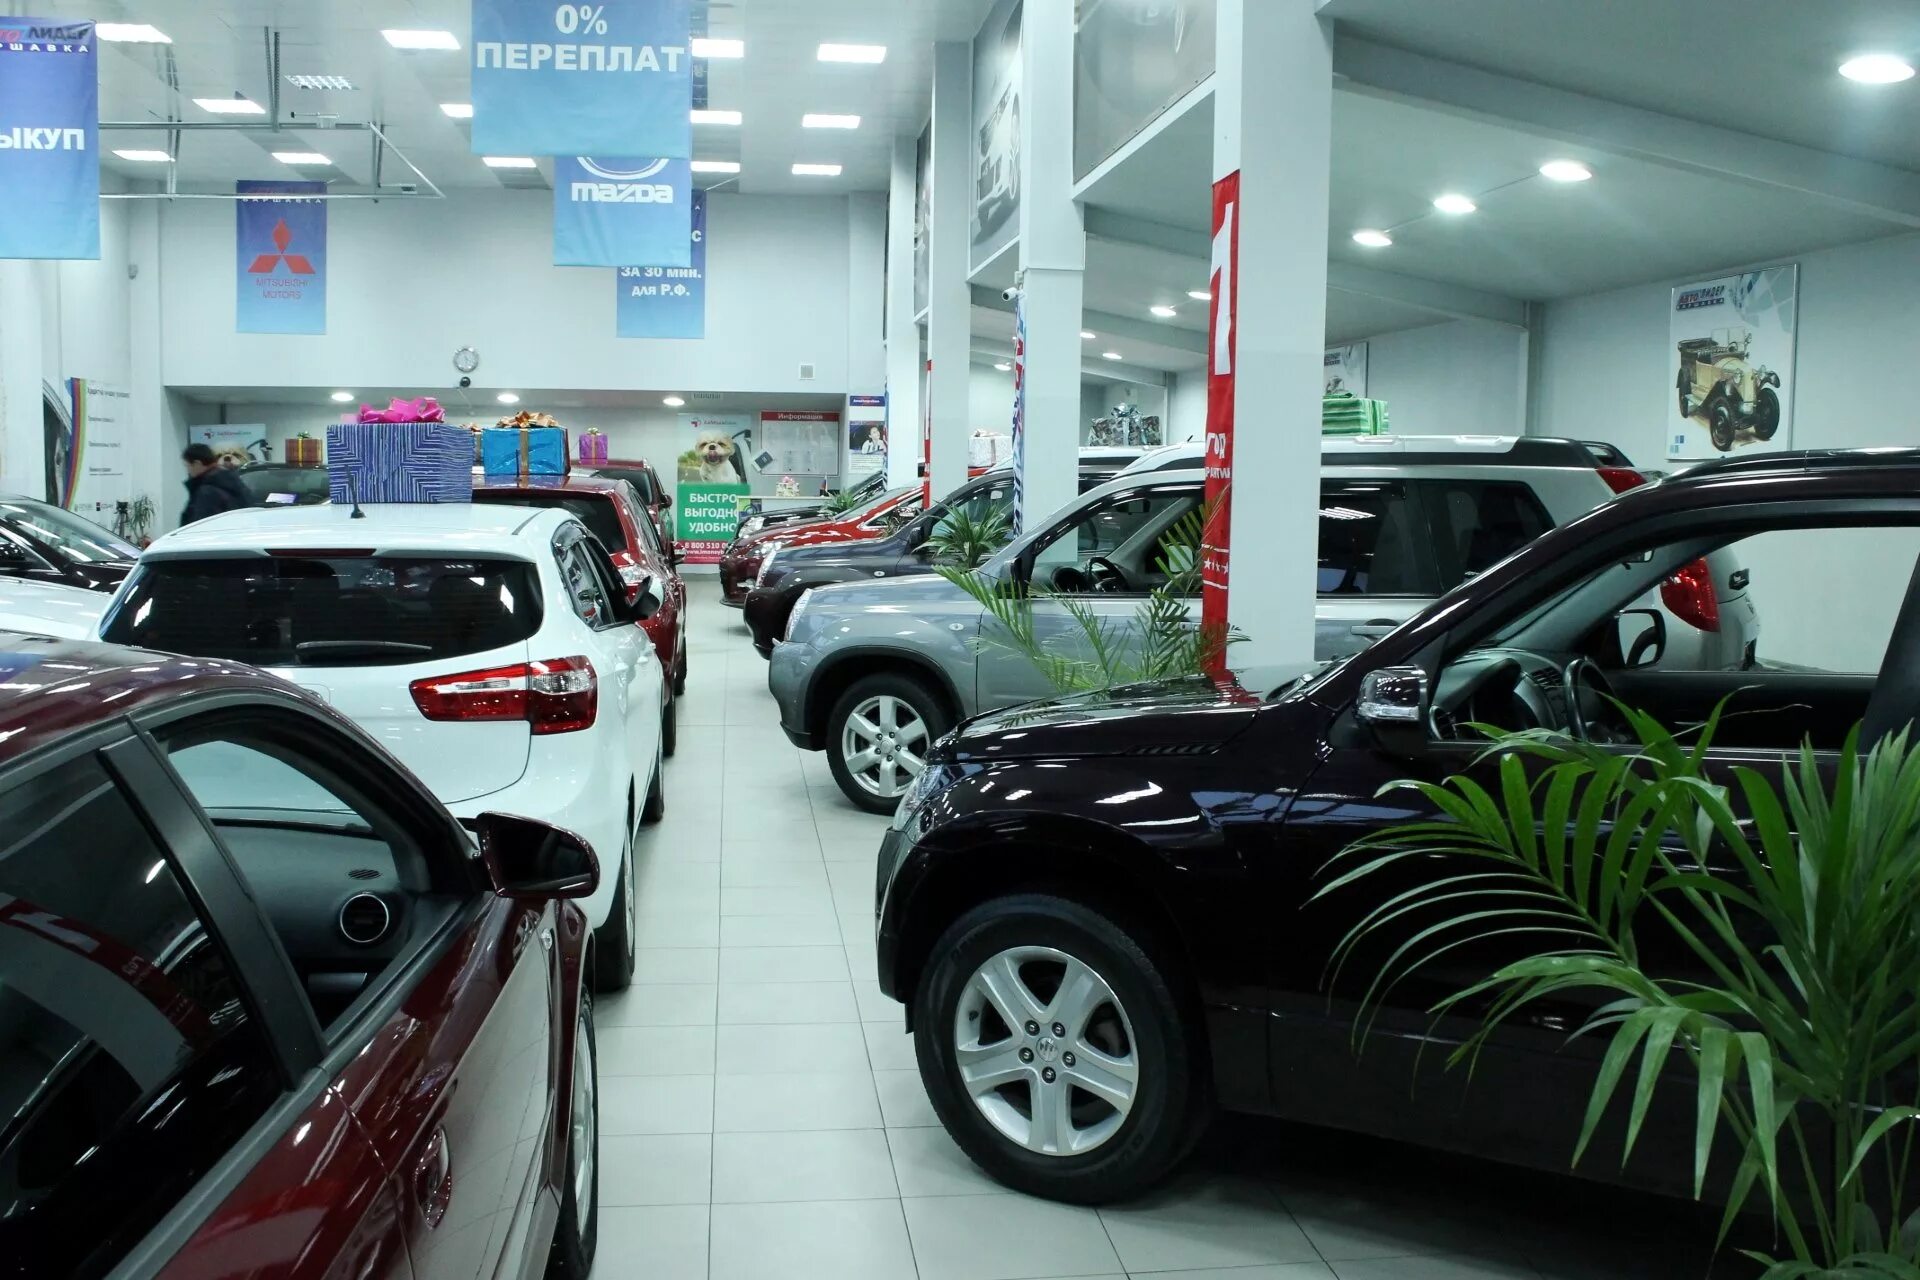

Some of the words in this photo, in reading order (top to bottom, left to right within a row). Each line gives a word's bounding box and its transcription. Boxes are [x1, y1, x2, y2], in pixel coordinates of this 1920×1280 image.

[555, 4, 608, 35] 0%
[0, 43, 88, 53] ШАВКА
[476, 42, 685, 73] ПЕРЕПЛАТ
[0, 127, 85, 151] ЫКУП
[620, 266, 641, 277] ЗА
[644, 267, 663, 277] 30
[255, 278, 311, 287] MITSUBISHI
[631, 285, 657, 297] для
[660, 283, 691, 296] Р.Ф.
[778, 411, 823, 421] Информация
[689, 493, 737, 503] БЫСТРО
[689, 522, 737, 534] УДОБНО
